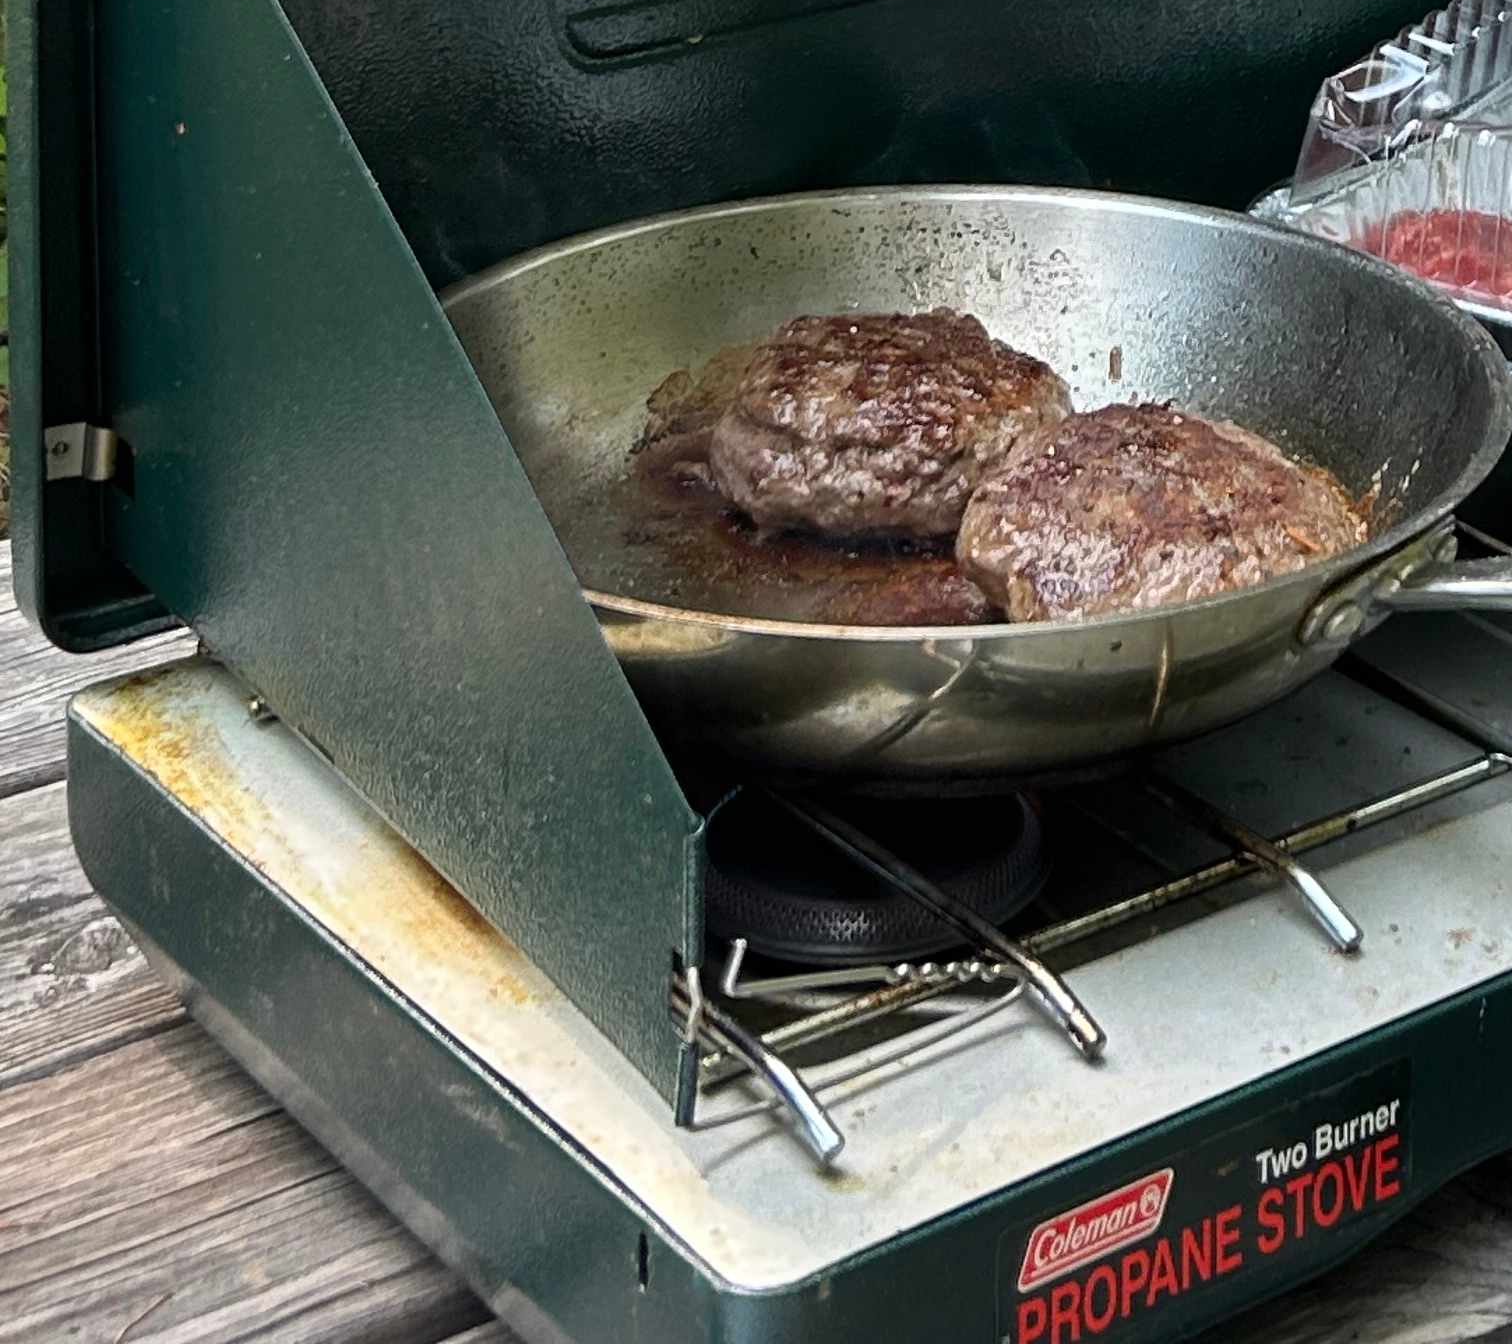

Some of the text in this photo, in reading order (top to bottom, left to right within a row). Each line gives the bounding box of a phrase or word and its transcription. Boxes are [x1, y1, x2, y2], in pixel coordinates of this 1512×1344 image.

[1256, 1099, 1401, 1184] Two Burner
[1017, 1135, 1401, 1344] PROPANE STOVE
[1033, 1199, 1137, 1268] Coleman
